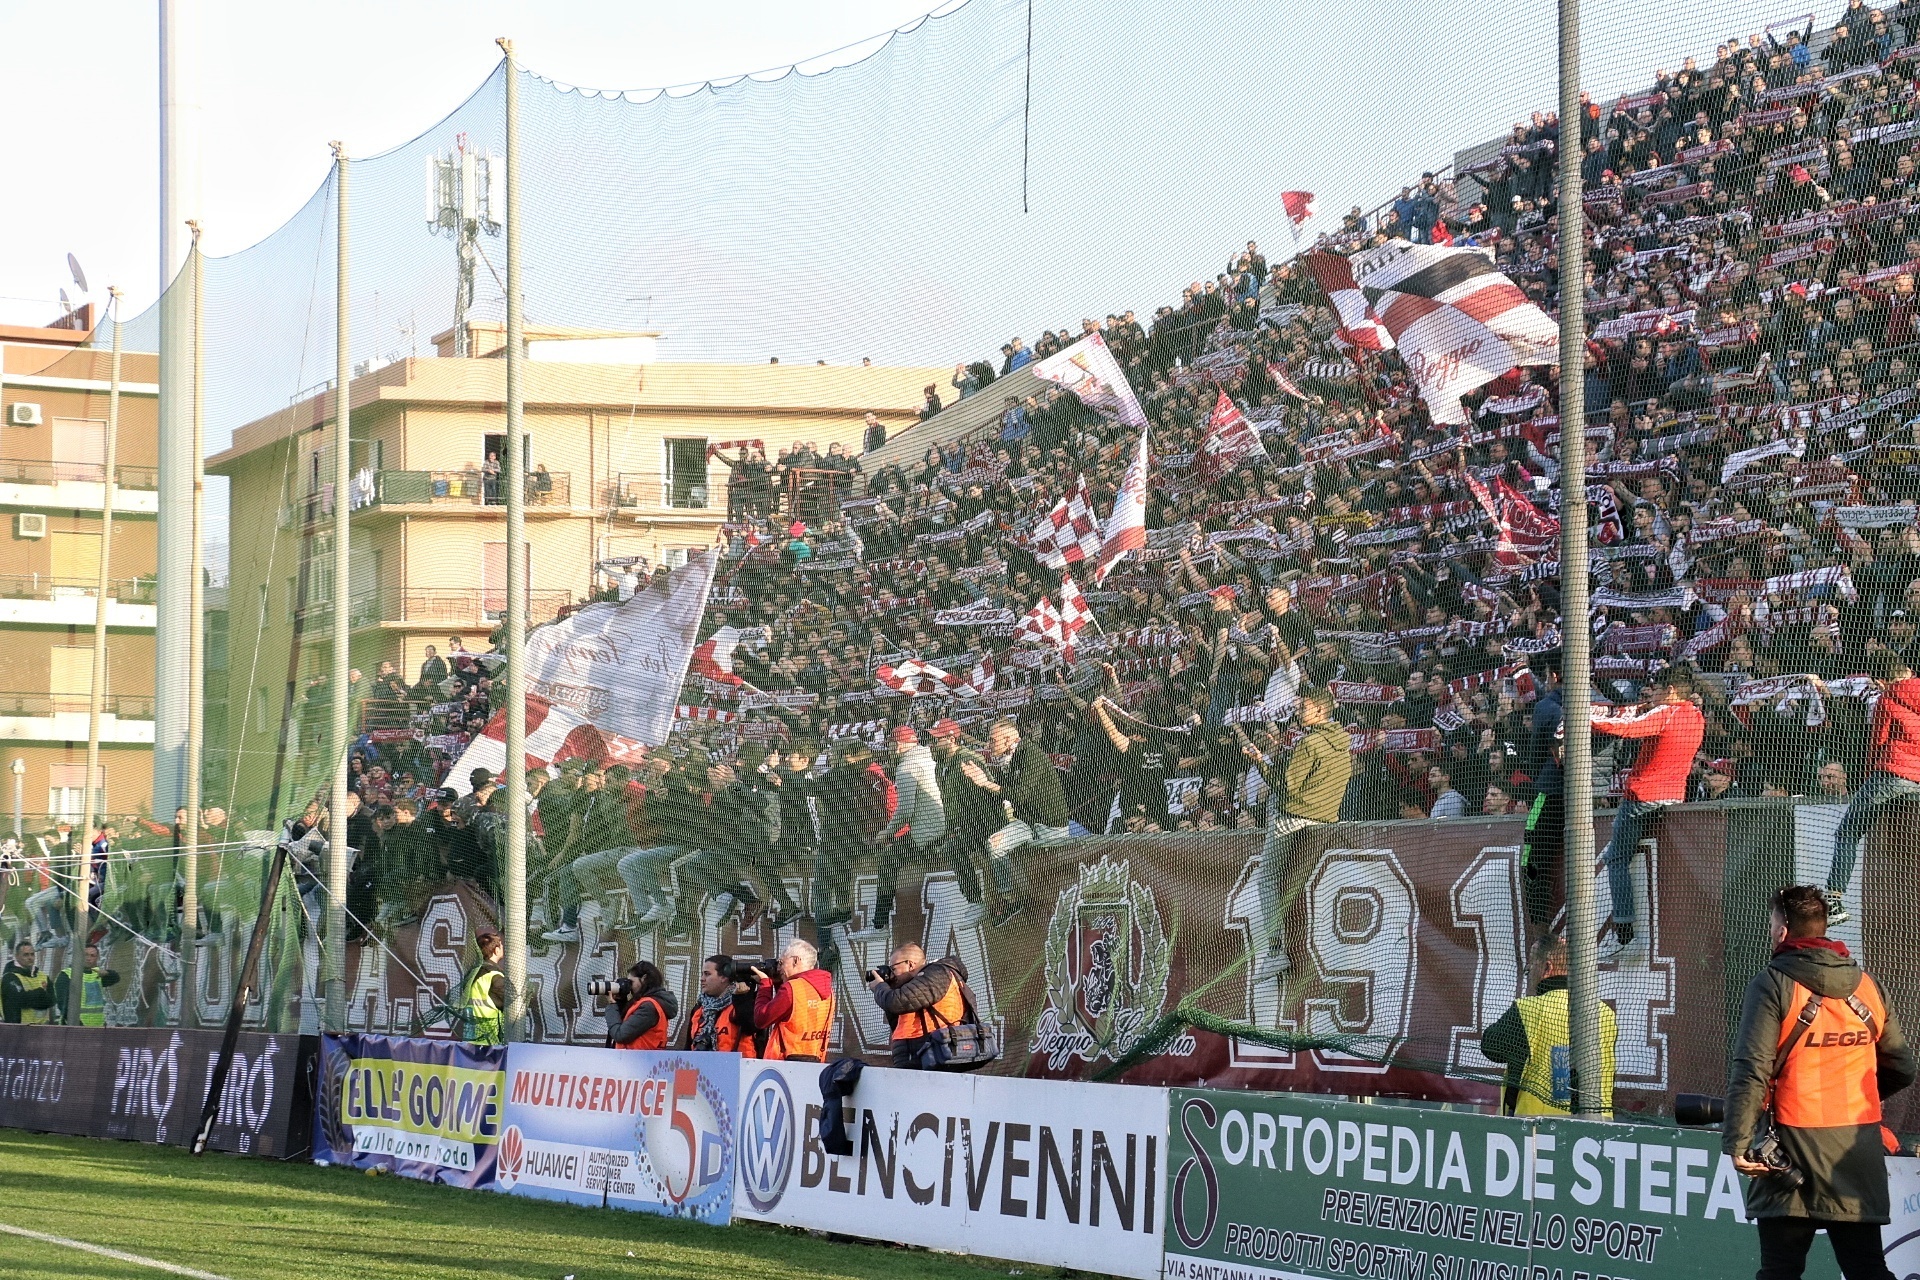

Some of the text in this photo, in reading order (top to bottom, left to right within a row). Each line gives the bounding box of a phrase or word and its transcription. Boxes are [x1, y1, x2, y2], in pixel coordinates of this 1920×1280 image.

[1409, 340, 1483, 391] Reggio
[1225, 839, 1676, 1091] 1914
[1030, 1008, 1094, 1070] Reggio
[0, 1057, 64, 1103] ranzo
[511, 1071, 668, 1116] MULTISERVICE
[525, 1150, 629, 1181] HUAWEI AUTHORIZED
[585, 1177, 636, 1195] SERVICE CENTER
[587, 1165, 621, 1180] CUSTOMER
[800, 1104, 1157, 1234] BENCIVENNI
[1220, 1109, 1757, 1225] ORTOPEDIA DE STEFA
[1224, 1223, 1325, 1269] PRODOTTI
[1327, 1238, 1428, 1280] SPORTIVI
[1321, 1188, 1663, 1264] PREVENZIONE NELLO SPORT
[1167, 1259, 1187, 1278] VIA
